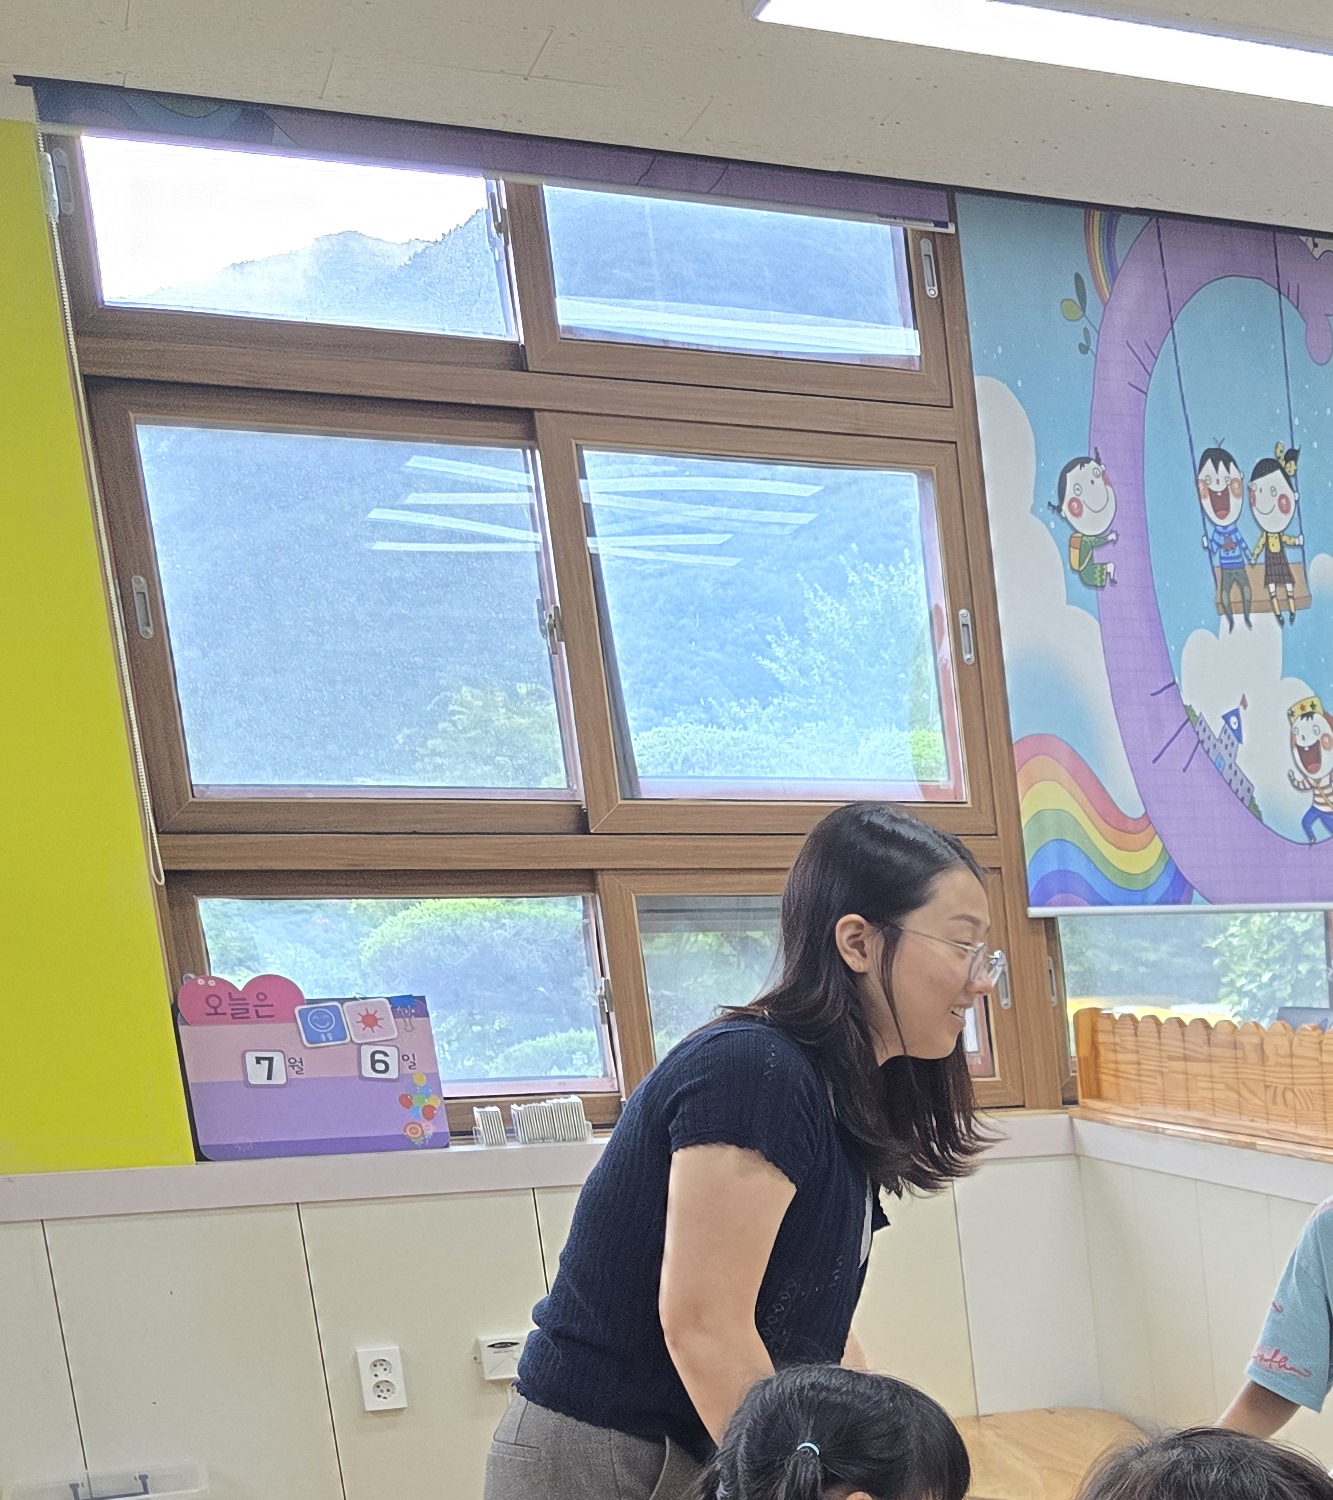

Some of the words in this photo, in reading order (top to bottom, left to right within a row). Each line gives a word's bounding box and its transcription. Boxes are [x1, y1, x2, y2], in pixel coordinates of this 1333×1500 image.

[204, 991, 276, 1021] 오늘은
[254, 1056, 275, 1081] 7
[287, 1056, 305, 1076] 월
[369, 1049, 391, 1075] 6
[401, 1053, 418, 1071] 일
